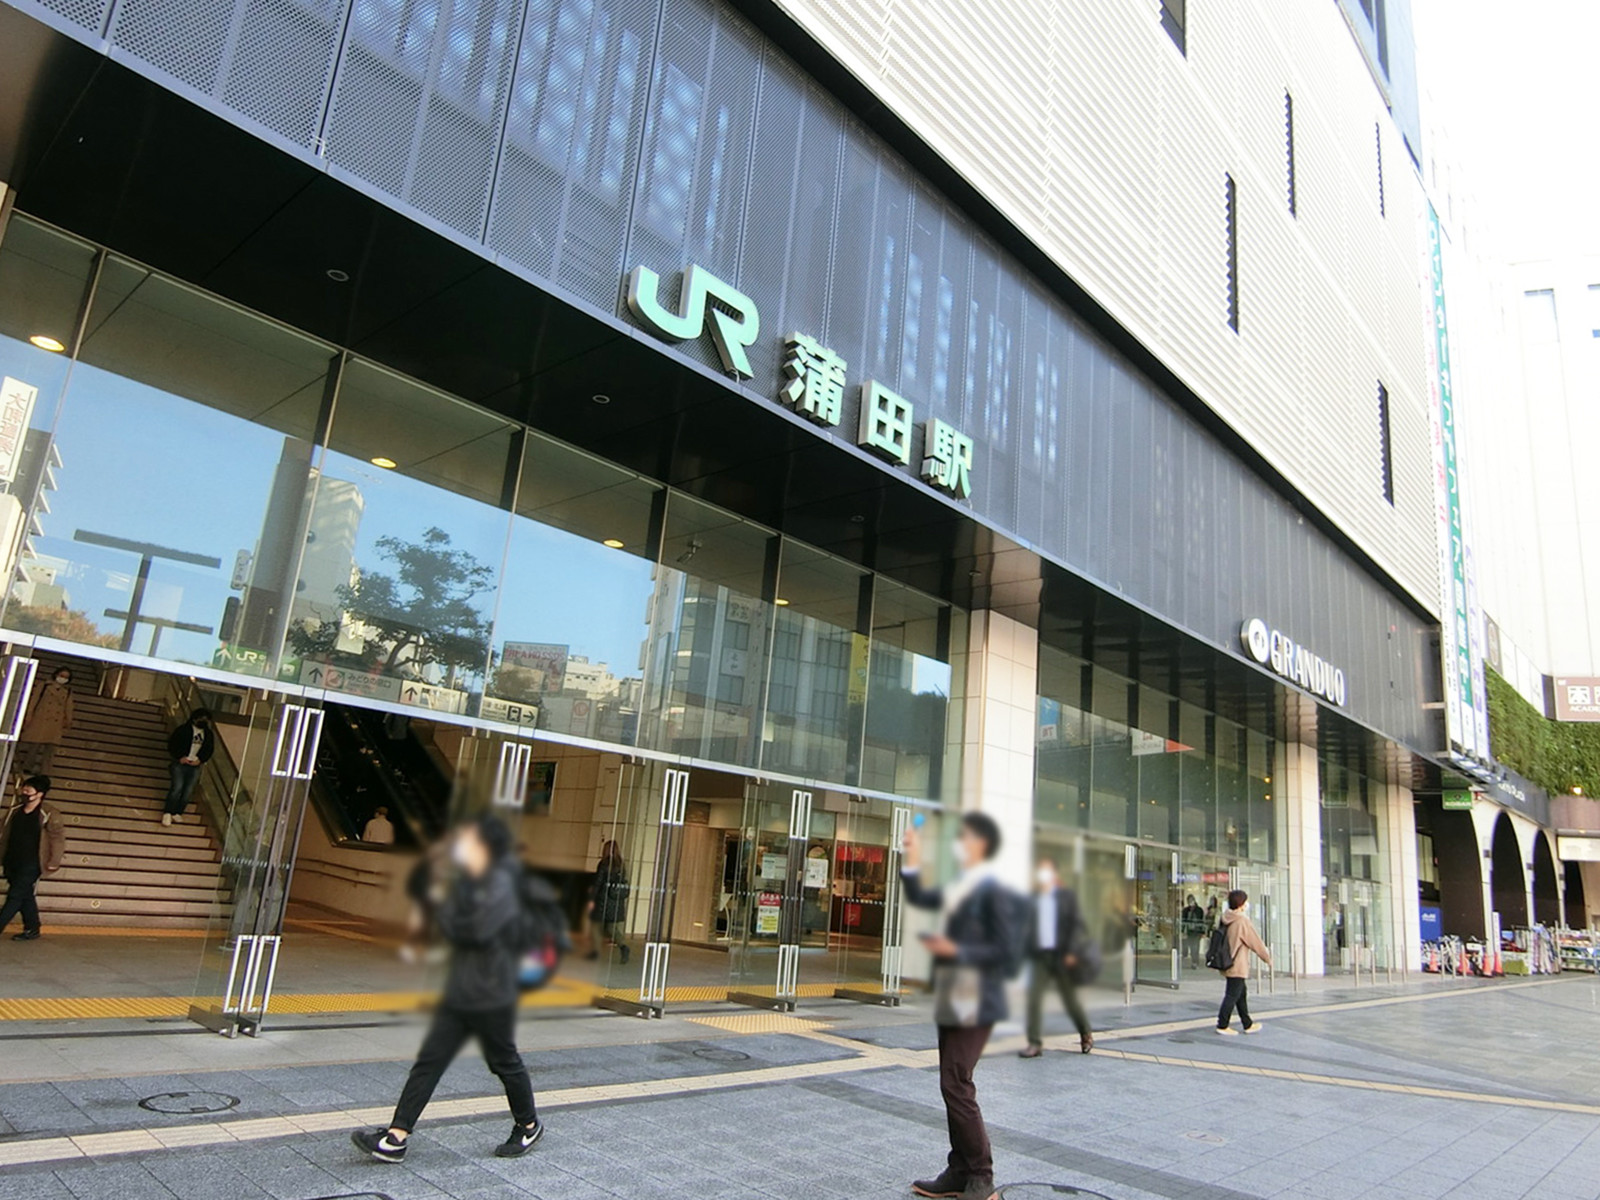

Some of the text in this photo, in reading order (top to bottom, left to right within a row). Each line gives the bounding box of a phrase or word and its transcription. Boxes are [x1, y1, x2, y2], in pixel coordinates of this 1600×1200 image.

[628, 263, 974, 500] JR 蒲田駅
[236, 651, 258, 664] JR
[1271, 630, 1345, 707] GRANDUO
